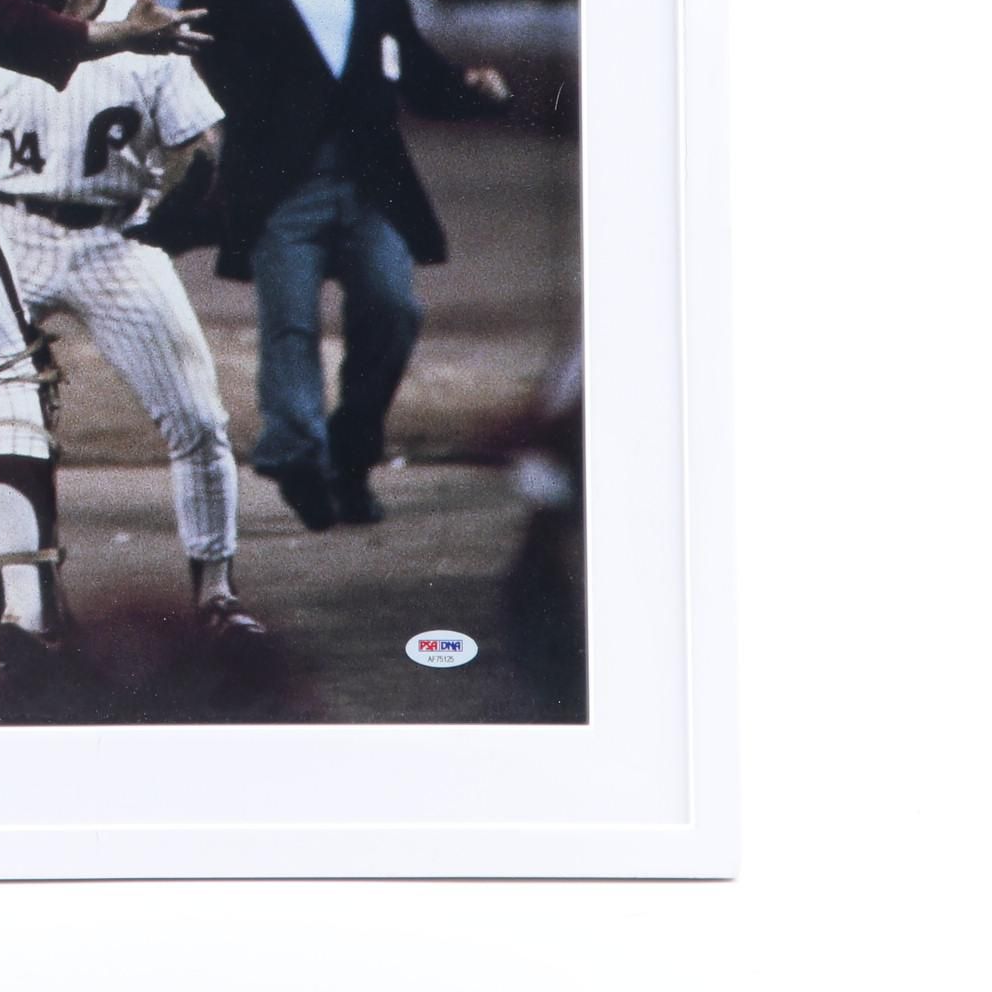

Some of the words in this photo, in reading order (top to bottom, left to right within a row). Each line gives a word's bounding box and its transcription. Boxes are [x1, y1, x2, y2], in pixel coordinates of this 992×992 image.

[83, 104, 145, 177] P
[419, 641, 438, 651] PSA
[441, 641, 461, 651] DNA
